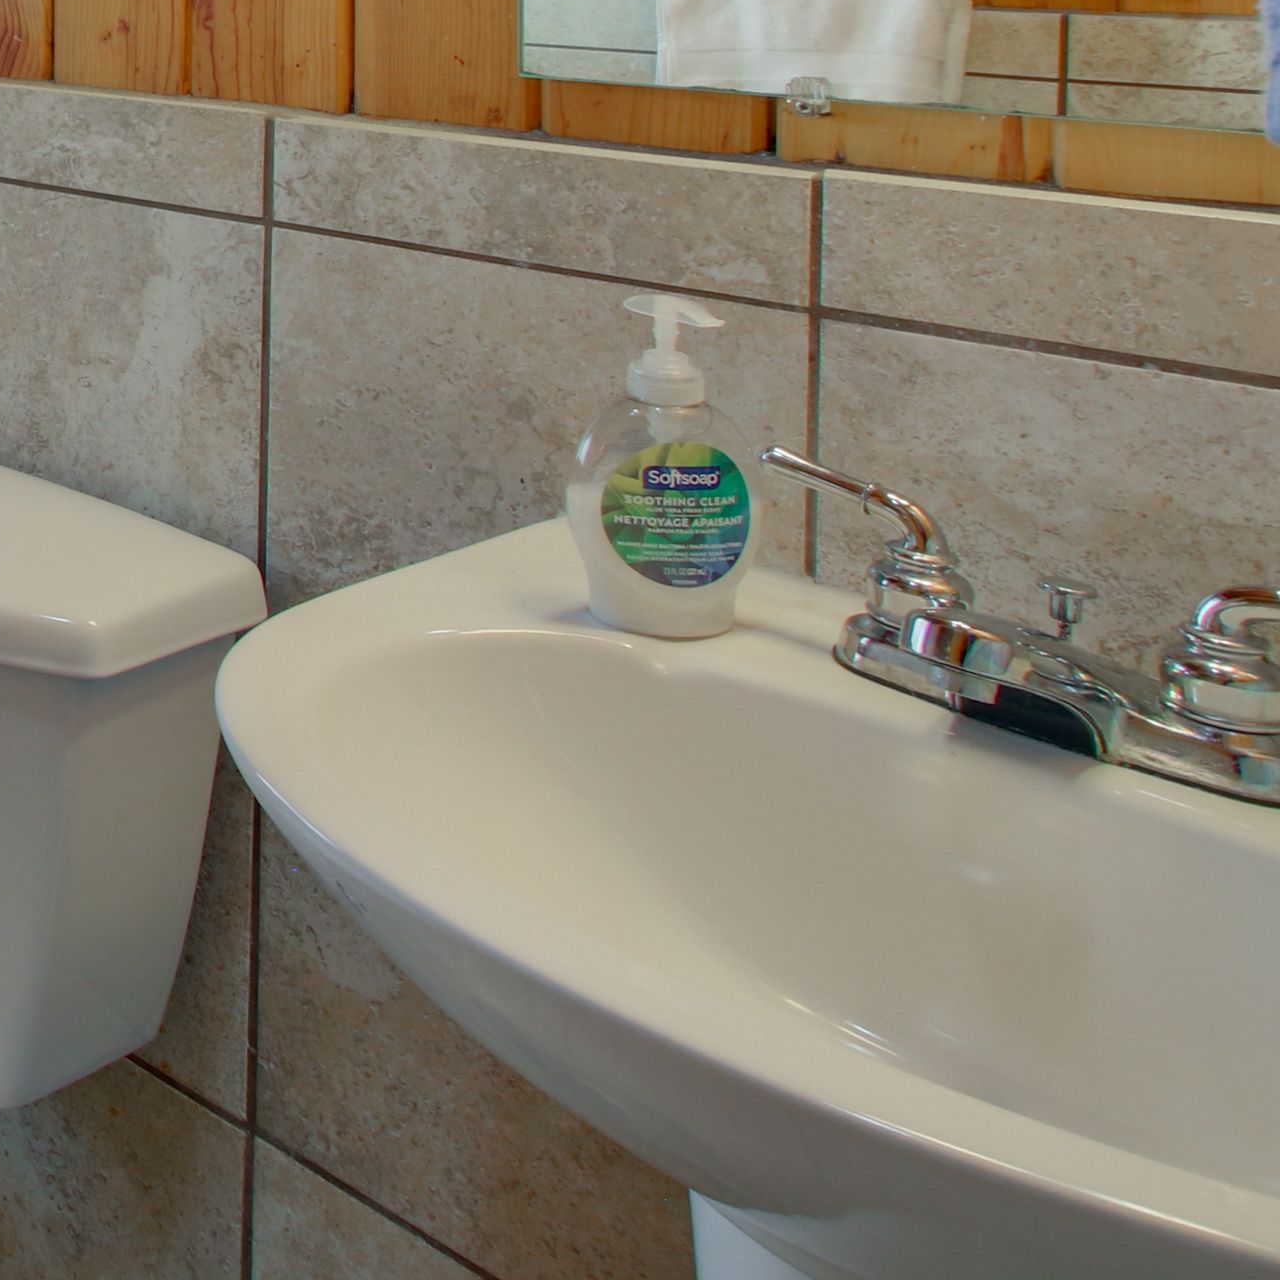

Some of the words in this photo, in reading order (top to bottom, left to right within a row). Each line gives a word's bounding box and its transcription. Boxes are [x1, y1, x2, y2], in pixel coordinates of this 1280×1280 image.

[648, 470, 718, 488] Softsoap
[623, 495, 696, 506] SOOTHING
[699, 495, 736, 506] CLEAN
[613, 515, 689, 527] NETTOYAGE
[690, 515, 743, 527] APAISANT
